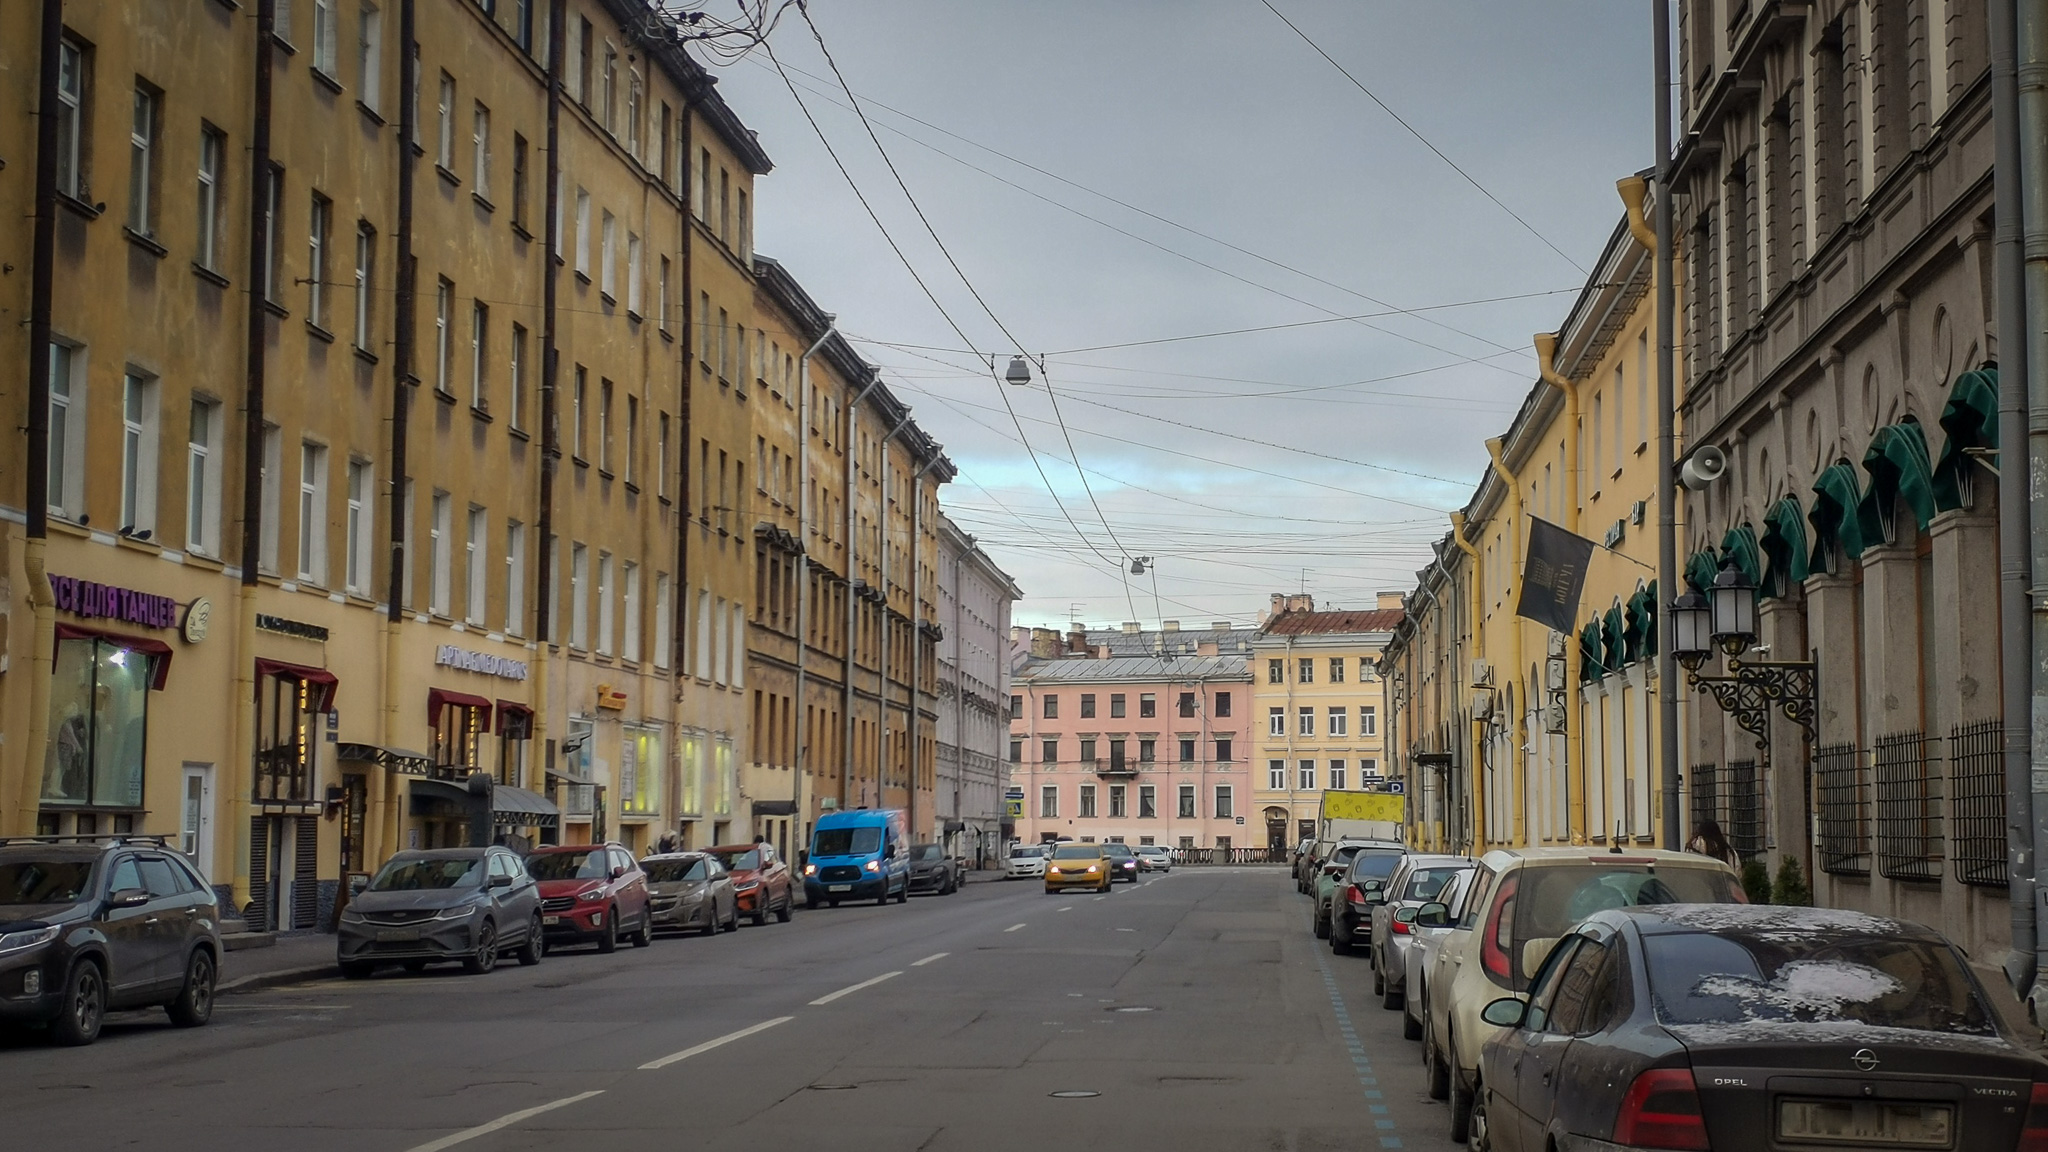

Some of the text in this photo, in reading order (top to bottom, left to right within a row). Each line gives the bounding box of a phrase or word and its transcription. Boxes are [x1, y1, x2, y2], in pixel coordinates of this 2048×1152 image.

[81, 580, 118, 617] ДЛЯ
[119, 588, 176, 629] ТАНЦЕВ
[1714, 1078, 1748, 1087] OPEL
[1973, 1087, 2018, 1097] VECTRA
